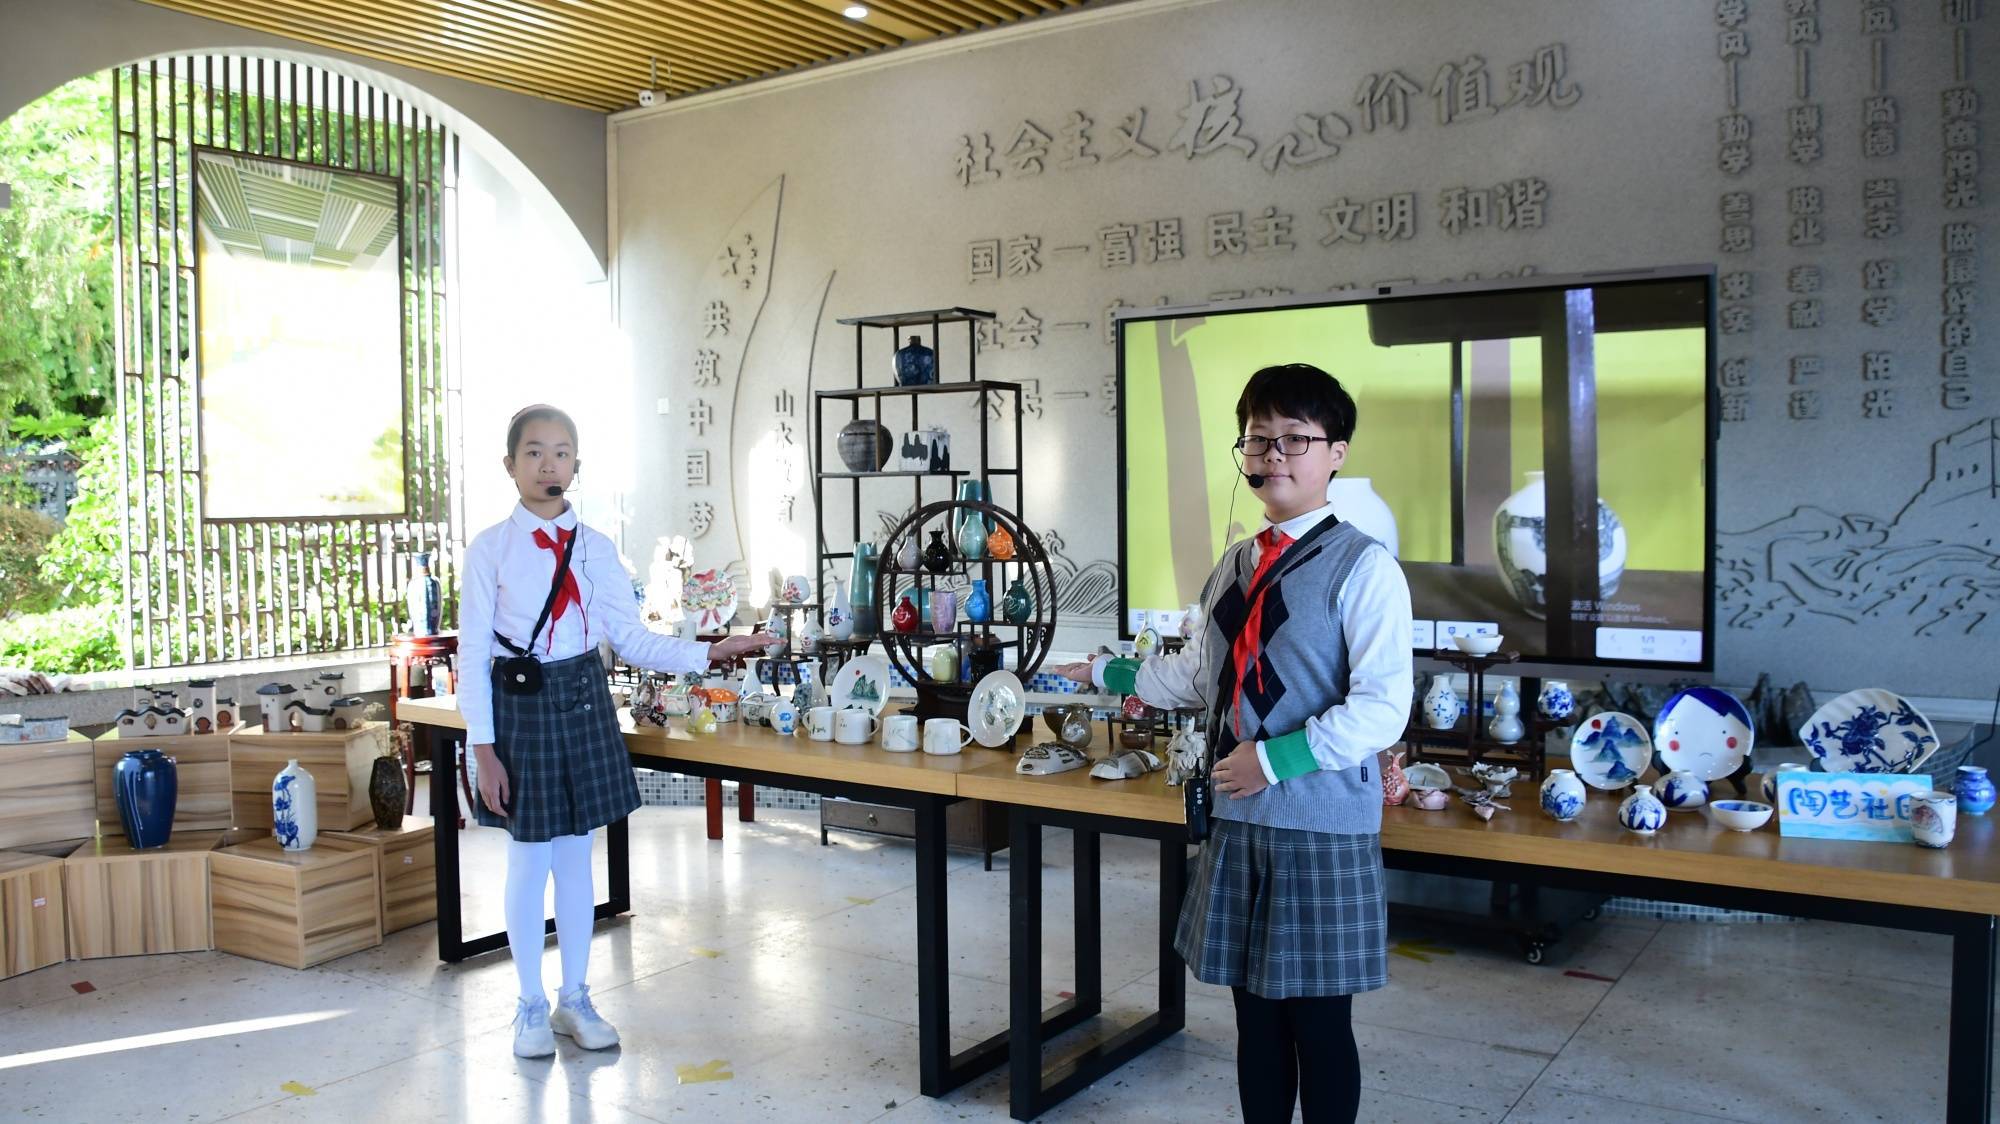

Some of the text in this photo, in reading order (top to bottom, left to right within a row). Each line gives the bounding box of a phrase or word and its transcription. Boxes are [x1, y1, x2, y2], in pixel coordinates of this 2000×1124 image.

[955, 42, 1583, 187] 社会主义核心价值观
[1206, 205, 1297, 258] 民主
[1320, 191, 1416, 249] 文明
[1440, 176, 1548, 237] 和谐
[687, 300, 731, 540] 共筑中国梦
